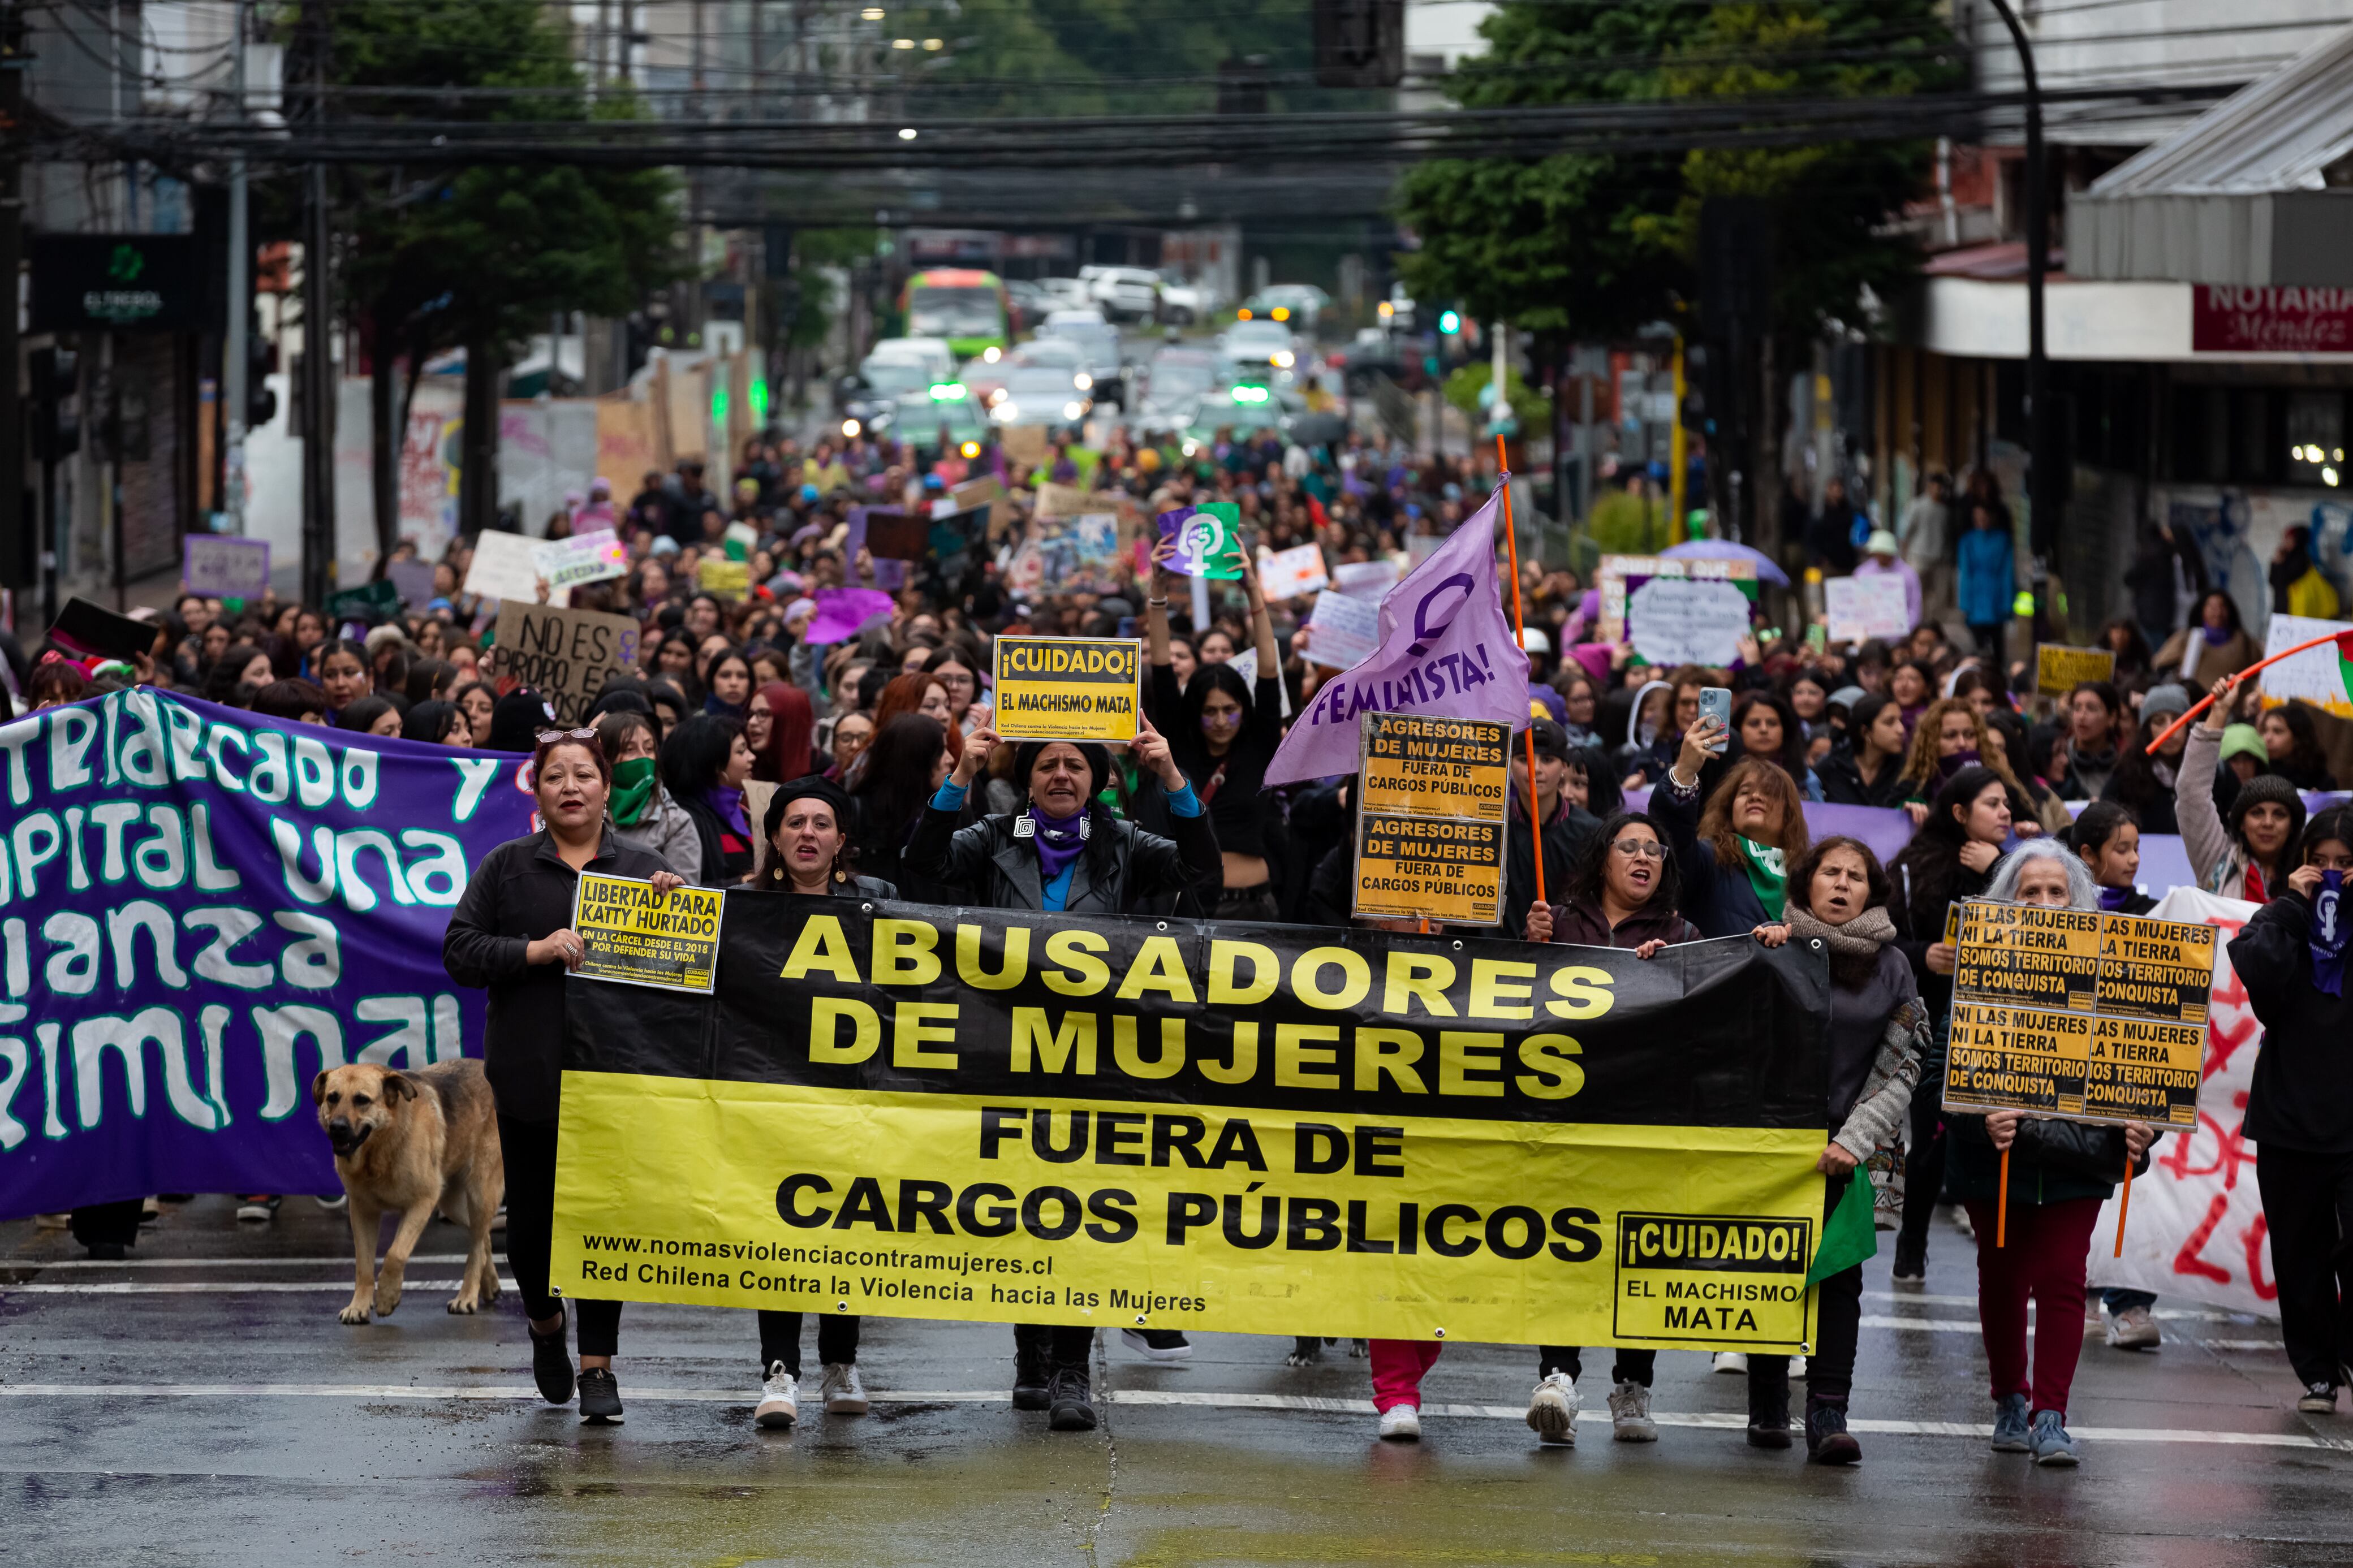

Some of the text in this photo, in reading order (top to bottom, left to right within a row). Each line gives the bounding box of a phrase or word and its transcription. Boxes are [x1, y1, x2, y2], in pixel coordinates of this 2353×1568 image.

[520, 613, 610, 663] NO ES
[1003, 647, 1133, 677] ¡CUIDADO!
[1311, 643, 1496, 725] FEMINISTA!
[1001, 693, 1132, 714] EL MACHISMO MATA
[1379, 719, 1500, 742] AGRESORES
[1375, 739, 1502, 762] DE MUJERES
[1402, 761, 1471, 778] FUERA DE
[448, 757, 501, 823] Y
[1368, 776, 1502, 798] CARGOS PÚBLICOS
[1371, 820, 1493, 841] AGRESORES
[1367, 840, 1495, 862] DE MUJERES
[1395, 861, 1464, 878] FUERA DE
[583, 881, 717, 917] LIBERTAD PARA
[1361, 876, 1496, 898] CARGOS PÚBLICOS
[581, 903, 715, 936] KATTY HURTADO
[1964, 906, 2098, 932] NI LAS MUJERES
[583, 930, 708, 954] EN LA CÁRCEL DESDE EL 2018
[1962, 927, 2068, 950] NI LA TIERRA
[2135, 921, 2210, 945] MUJERES
[592, 941, 696, 963] POR DEFENDER SU VIDA
[1960, 948, 2096, 975] SOMOS TERRITORIO
[2123, 940, 2181, 962] TIERRA
[779, 914, 1615, 1020] ABUSADORES
[2127, 962, 2209, 987] TERRITORIO
[1959, 968, 2066, 994] DE CONQUISTA
[2097, 980, 2178, 1005] CONQUISTA
[1955, 1006, 2088, 1035] NI LAS MUJERES
[2093, 1020, 2199, 1046] AS MUJERES
[809, 996, 1585, 1100] DE MUJERES
[1952, 1026, 2058, 1052] NI LA TIERRA
[1951, 1048, 2085, 1078] SOMOS TERRITORIO
[2111, 1043, 2170, 1064] TIERRA
[1949, 1069, 2055, 1096] DE CONQUISTA
[2116, 1064, 2197, 1089] TERRITORIO
[2087, 1083, 2167, 1107] CONQUISTA
[979, 1106, 1404, 1178] FUERA DE
[775, 1173, 1602, 1263] CARGOS PÚBLICOS
[583, 1234, 1053, 1276] www.nomasviolenciacontramujeres.cl
[1627, 1222, 1800, 1265] ¡CUIDADO!
[581, 1260, 1206, 1315] Red Chilena Contra la Violencia hacia las Mujeres
[1627, 1280, 1798, 1303] EL MACHISMO
[1664, 1306, 1758, 1332] MATA
